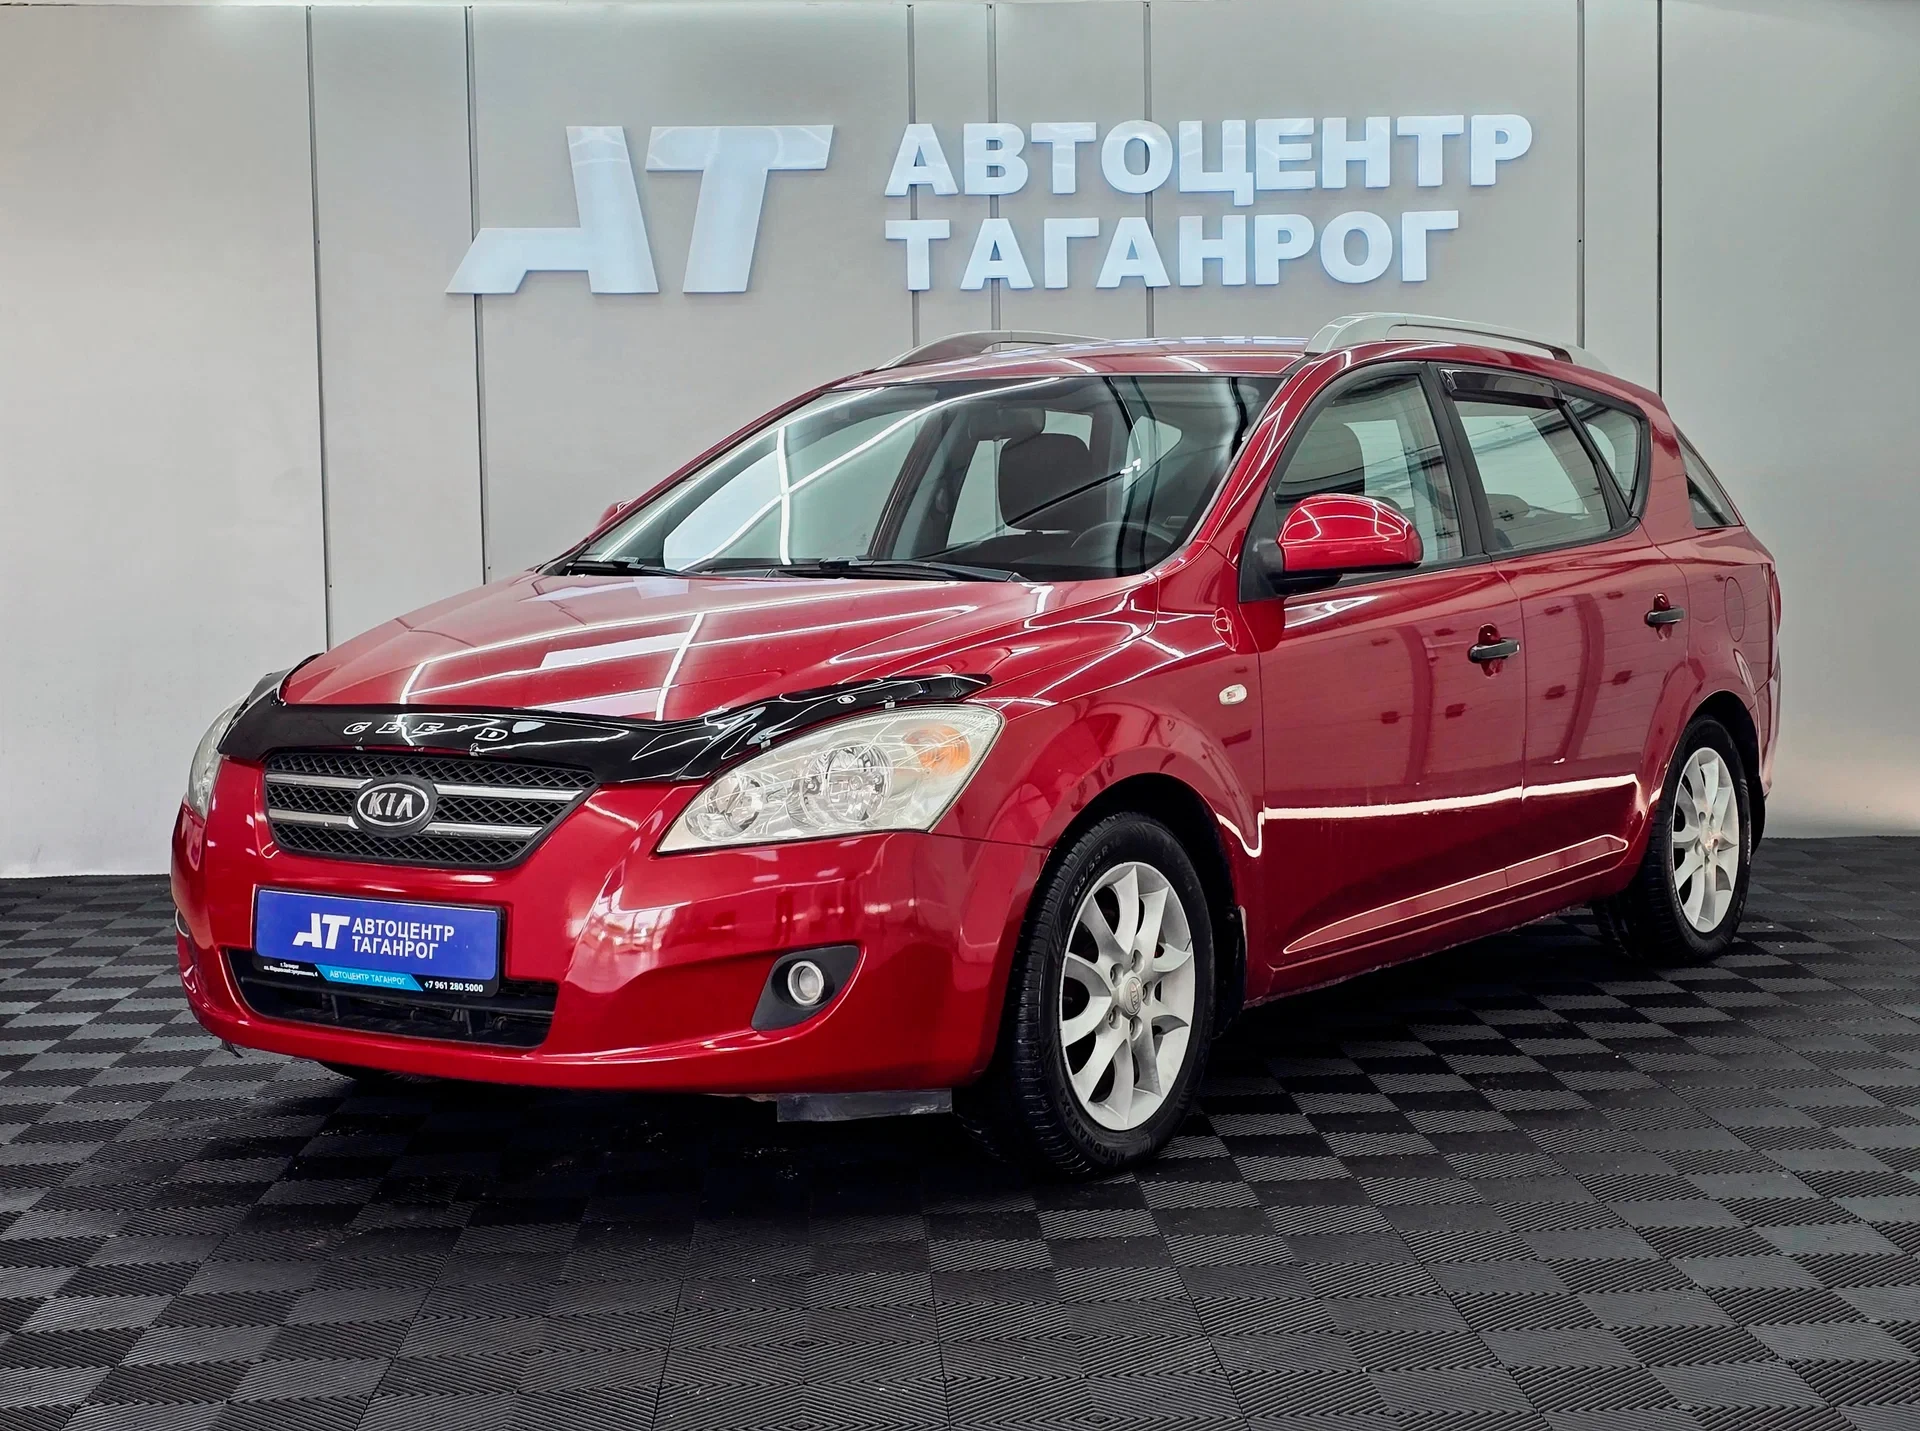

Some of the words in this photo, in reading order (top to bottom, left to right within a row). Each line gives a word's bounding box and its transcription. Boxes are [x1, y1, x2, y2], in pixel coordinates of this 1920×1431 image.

[885, 114, 1533, 206] АВТОЦЕНТР
[884, 209, 1460, 290] ТАГАНРОГ
[367, 791, 414, 819] KIA
[352, 917, 455, 942] АВТОЦЕНТР
[352, 935, 439, 960] ТАГАНРОГ
[329, 969, 370, 982] АВТОЦЕНТР
[370, 974, 406, 986] ТАГАНРОГ
[434, 980, 448, 990] 961
[449, 982, 464, 991] 280
[464, 983, 484, 993] 5000
